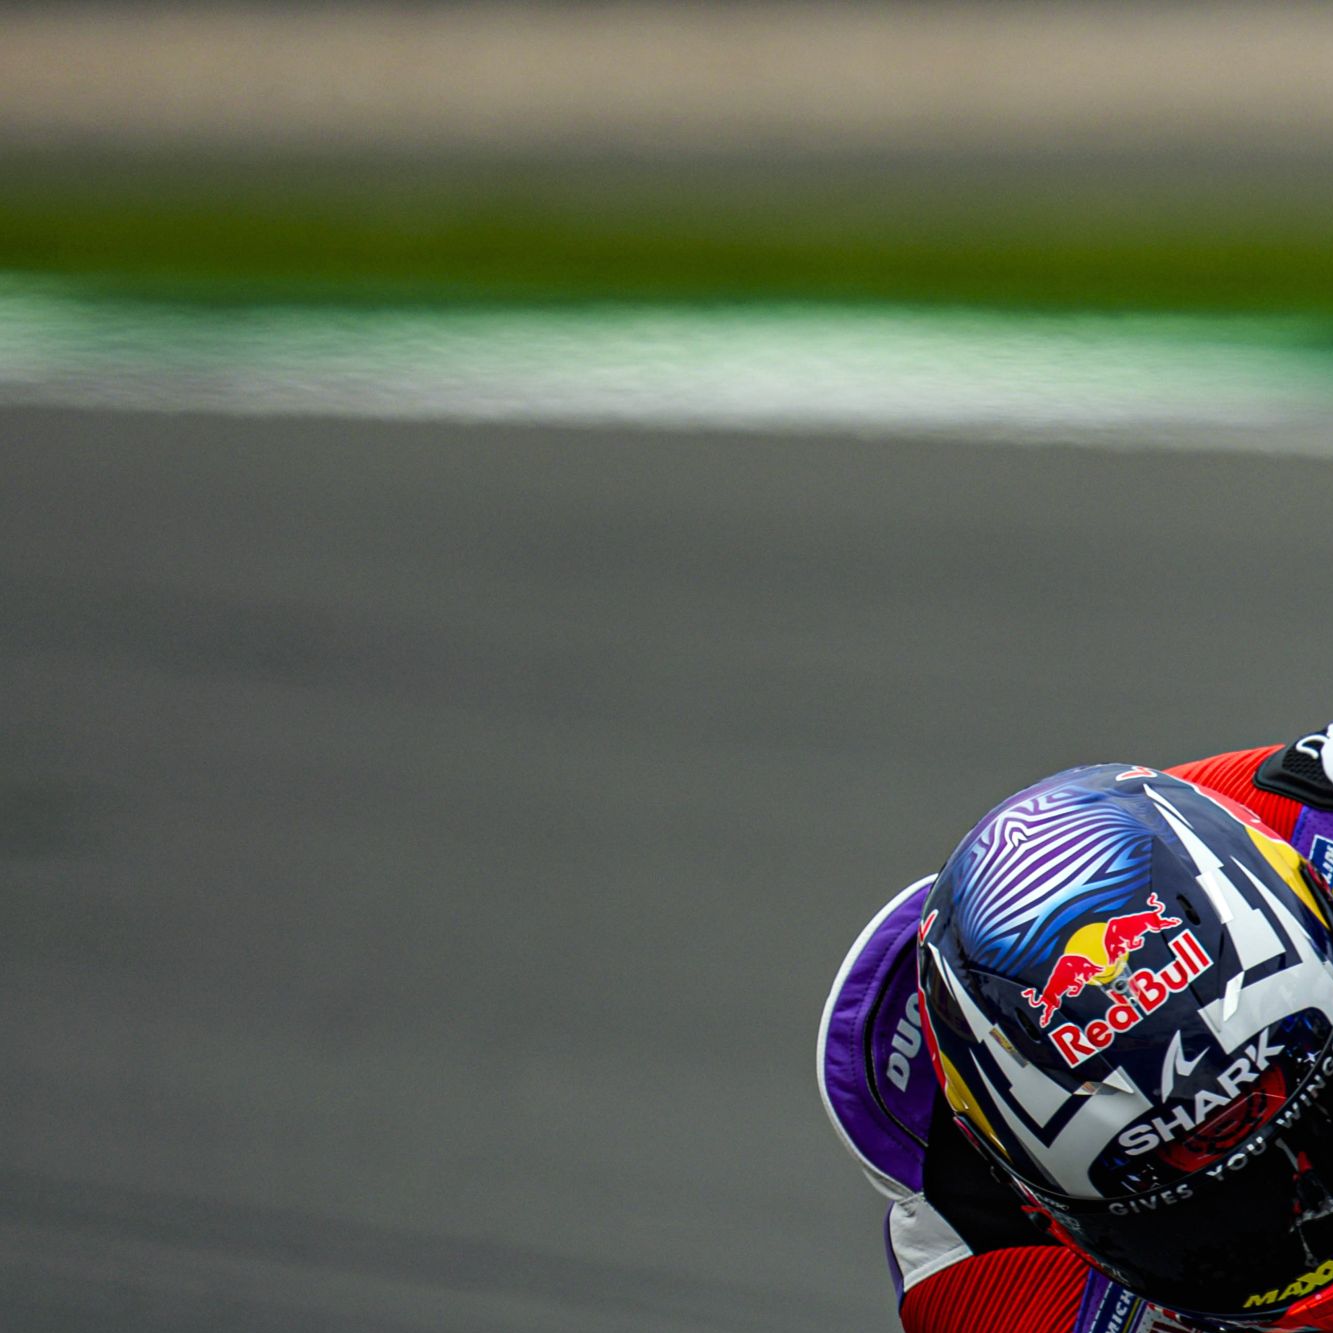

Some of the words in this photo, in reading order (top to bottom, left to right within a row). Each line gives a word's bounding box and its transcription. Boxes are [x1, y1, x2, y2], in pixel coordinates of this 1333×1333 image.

[1048, 989, 1143, 1068] Red
[1130, 928, 1214, 1015] Bull
[1118, 1027, 1285, 1155] SHARK
[1108, 1184, 1194, 1216] GIVES
[1206, 1136, 1267, 1181] YOU
